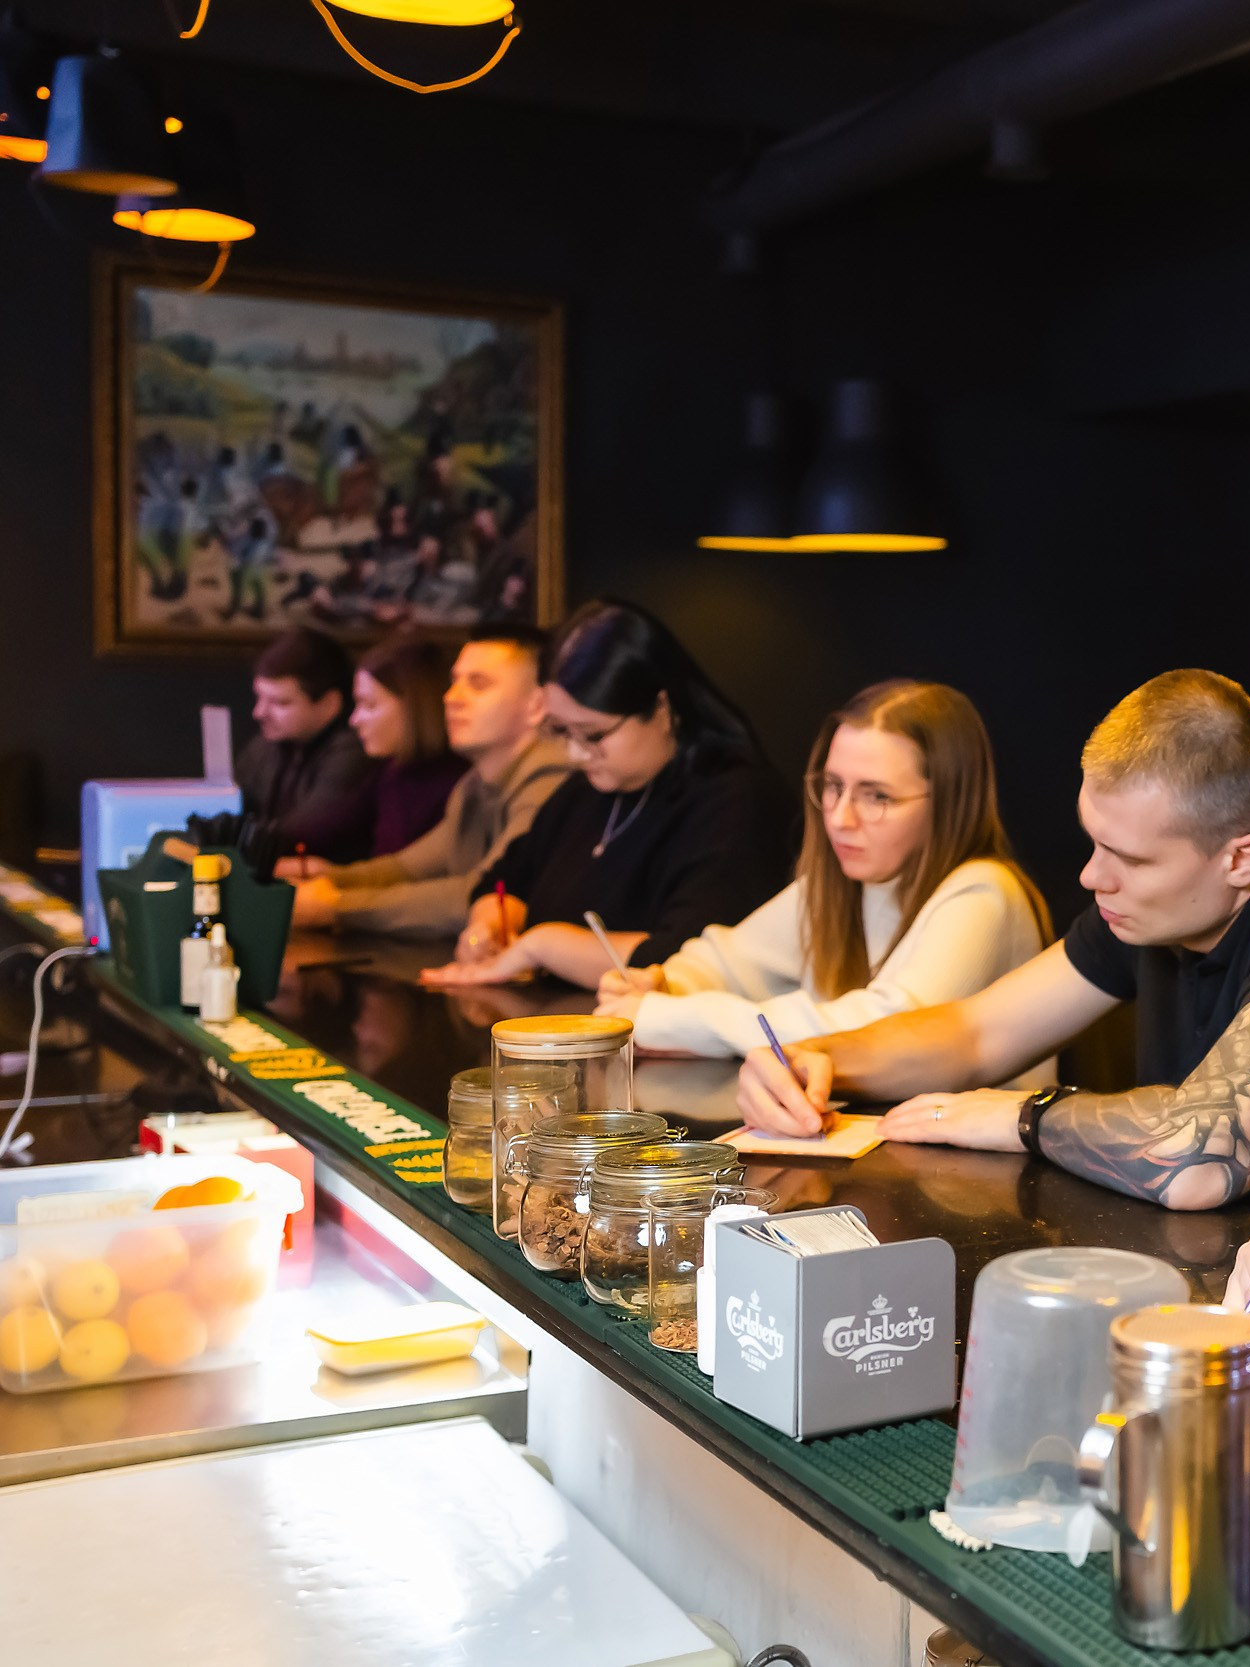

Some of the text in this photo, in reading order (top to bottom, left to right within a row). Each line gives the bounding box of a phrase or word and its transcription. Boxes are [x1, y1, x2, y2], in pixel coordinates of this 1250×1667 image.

[726, 1296, 785, 1360] Carlsberg
[823, 1314, 936, 1359] Carlsberg
[855, 1356, 904, 1373] PILSNER
